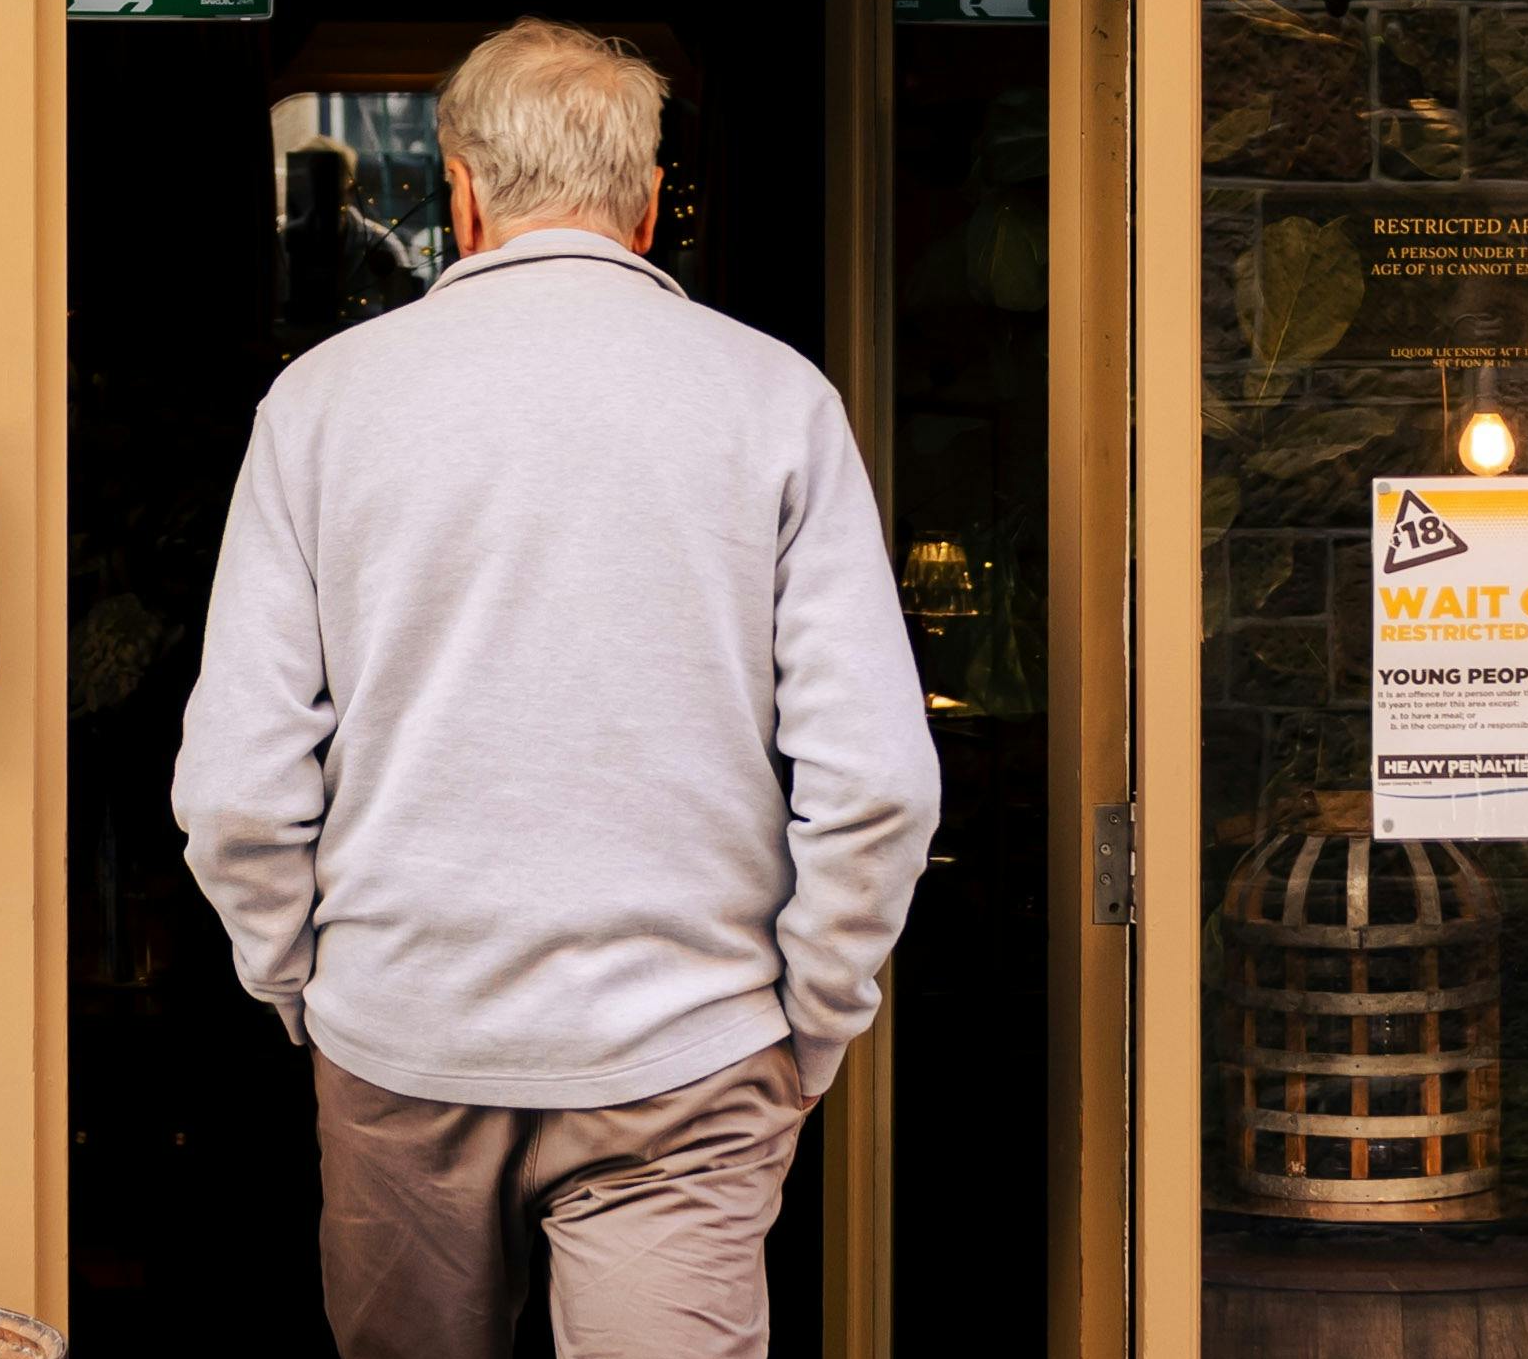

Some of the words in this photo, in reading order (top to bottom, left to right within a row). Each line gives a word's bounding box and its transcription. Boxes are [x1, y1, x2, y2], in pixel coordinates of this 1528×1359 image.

[1373, 218, 1502, 236] RESTRICTED
[1386, 247, 1398, 259] A
[1401, 247, 1457, 259] PERSON
[1462, 246, 1514, 259] UNDER
[1371, 263, 1402, 276] AGE
[1405, 263, 1426, 276] OF
[1430, 263, 1444, 276] 18
[1447, 263, 1511, 276] CANNOT
[1391, 347, 1433, 359] LIQUOR
[1436, 347, 1496, 358] LICENSING
[1500, 347, 1522, 358] ACT
[1400, 516, 1444, 550] 18
[1379, 585, 1510, 620] WAIT
[1378, 668, 1462, 685] YOUNG
[1408, 690, 1440, 698] offence
[1443, 690, 1454, 698] for
[1465, 690, 1494, 699] person
[1496, 689, 1521, 697] under
[1388, 702, 1411, 710] years
[1427, 723, 1466, 731] company
[1384, 760, 1446, 775] HEAVY
